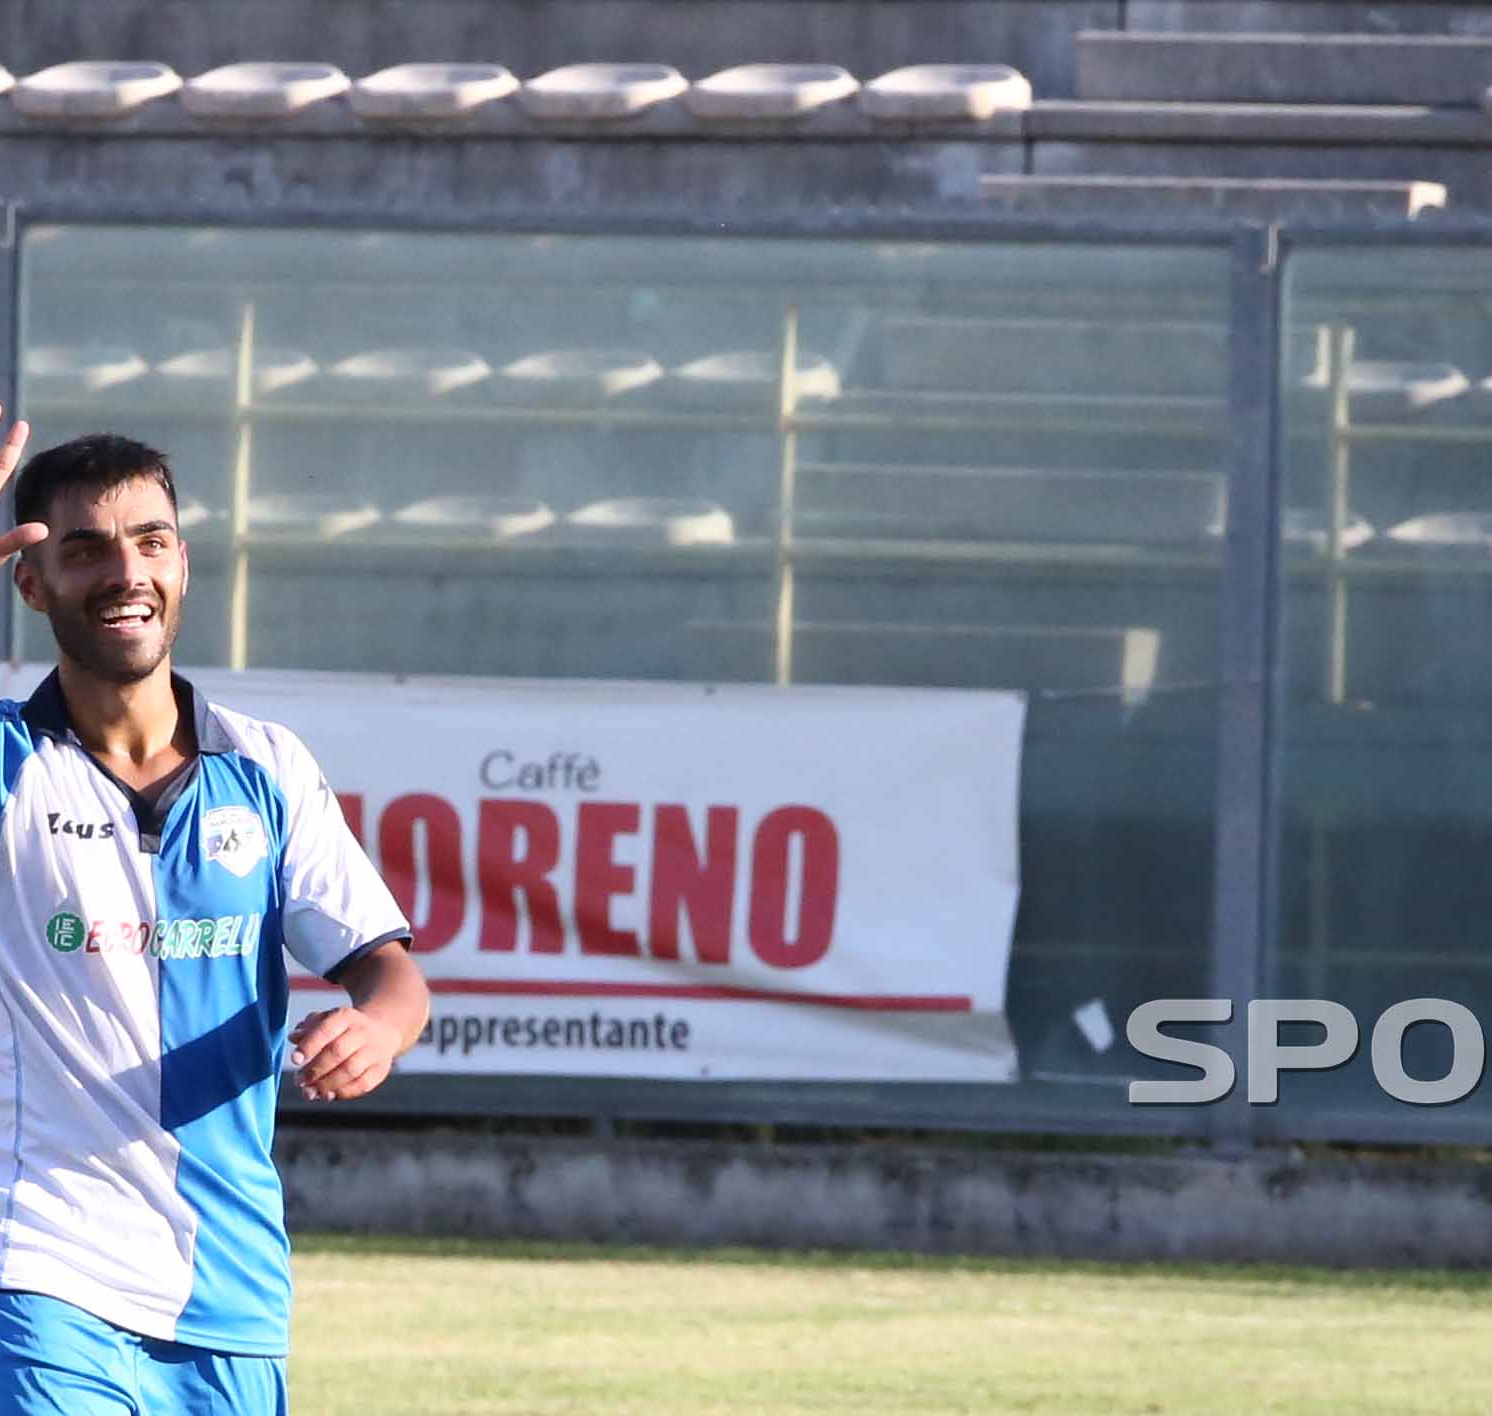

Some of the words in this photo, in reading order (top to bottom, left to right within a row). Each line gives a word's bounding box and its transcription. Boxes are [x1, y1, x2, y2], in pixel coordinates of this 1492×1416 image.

[479, 750, 601, 793] Caffè
[338, 792, 841, 971] ORENO
[415, 1011, 690, 1056] appresentante
